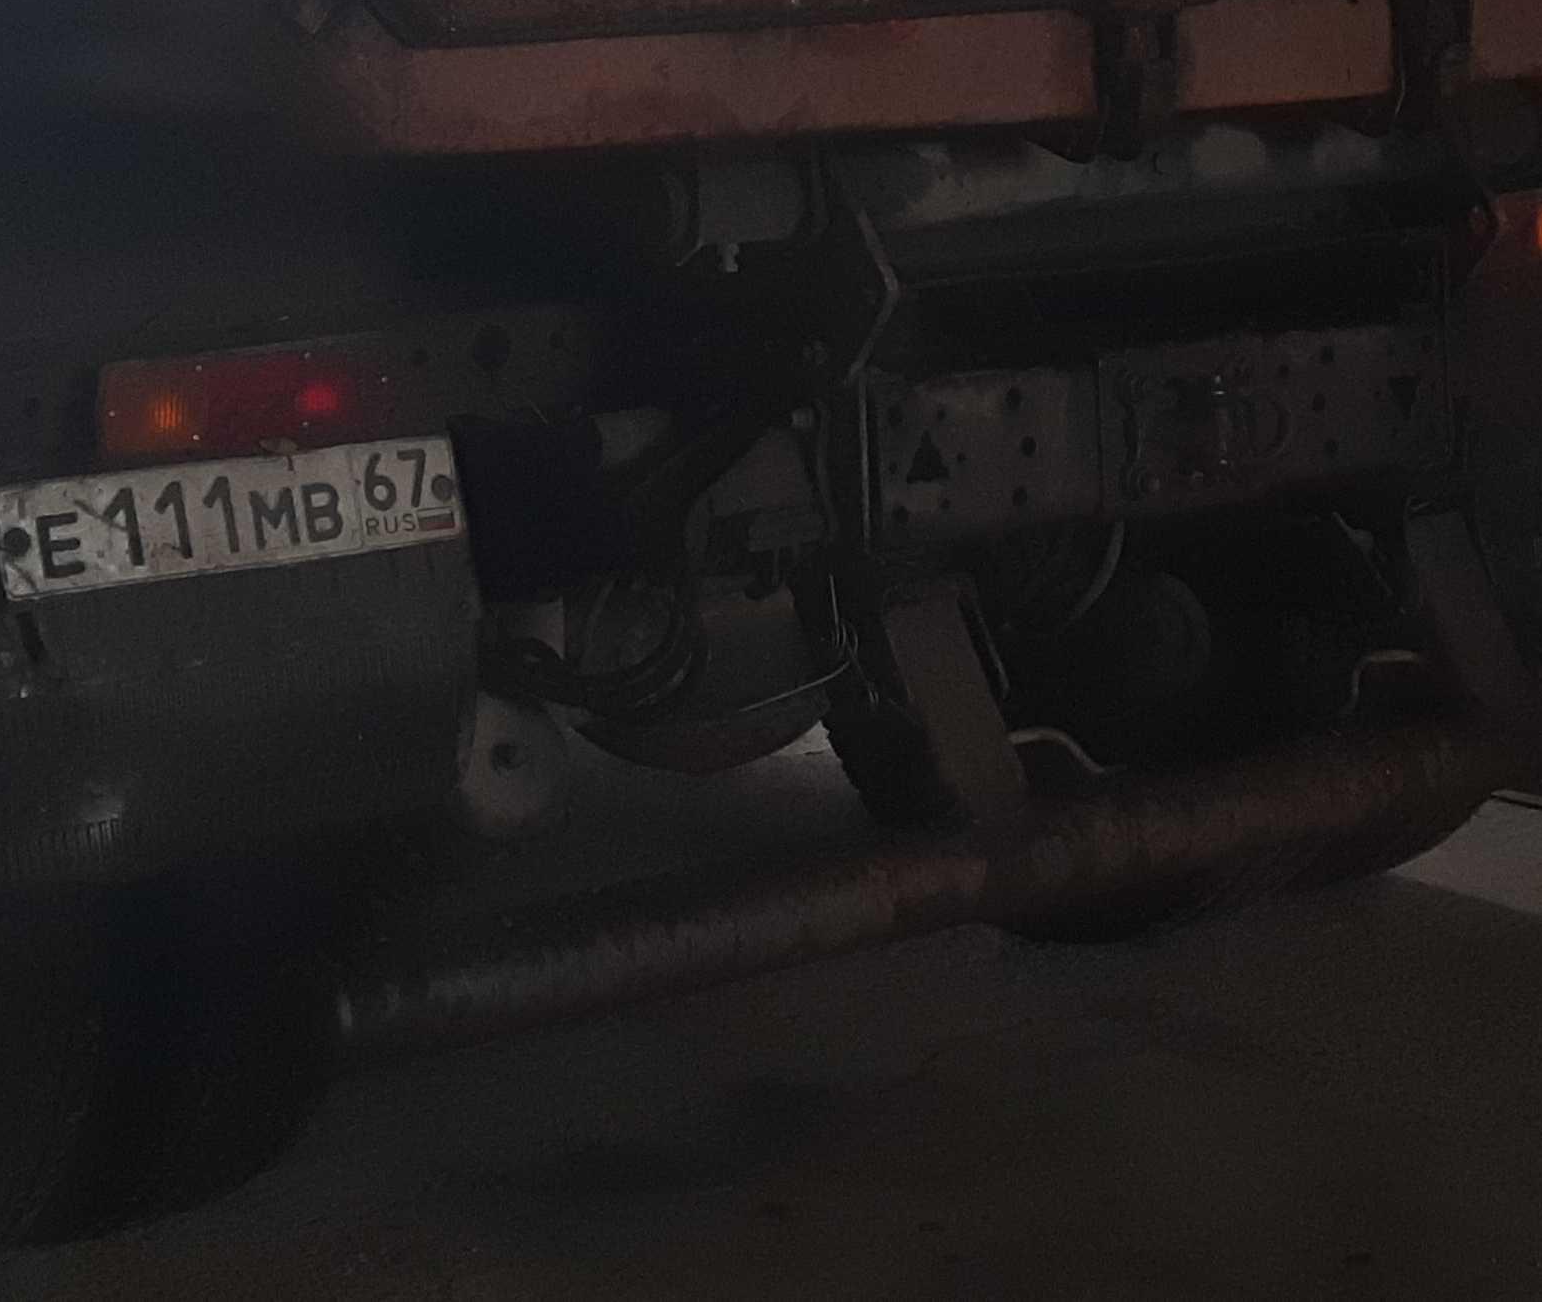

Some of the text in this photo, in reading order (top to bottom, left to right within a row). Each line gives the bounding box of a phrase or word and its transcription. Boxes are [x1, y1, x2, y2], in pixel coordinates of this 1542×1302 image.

[35, 448, 427, 580] Е111МВ 67
[365, 513, 417, 536] RUS
